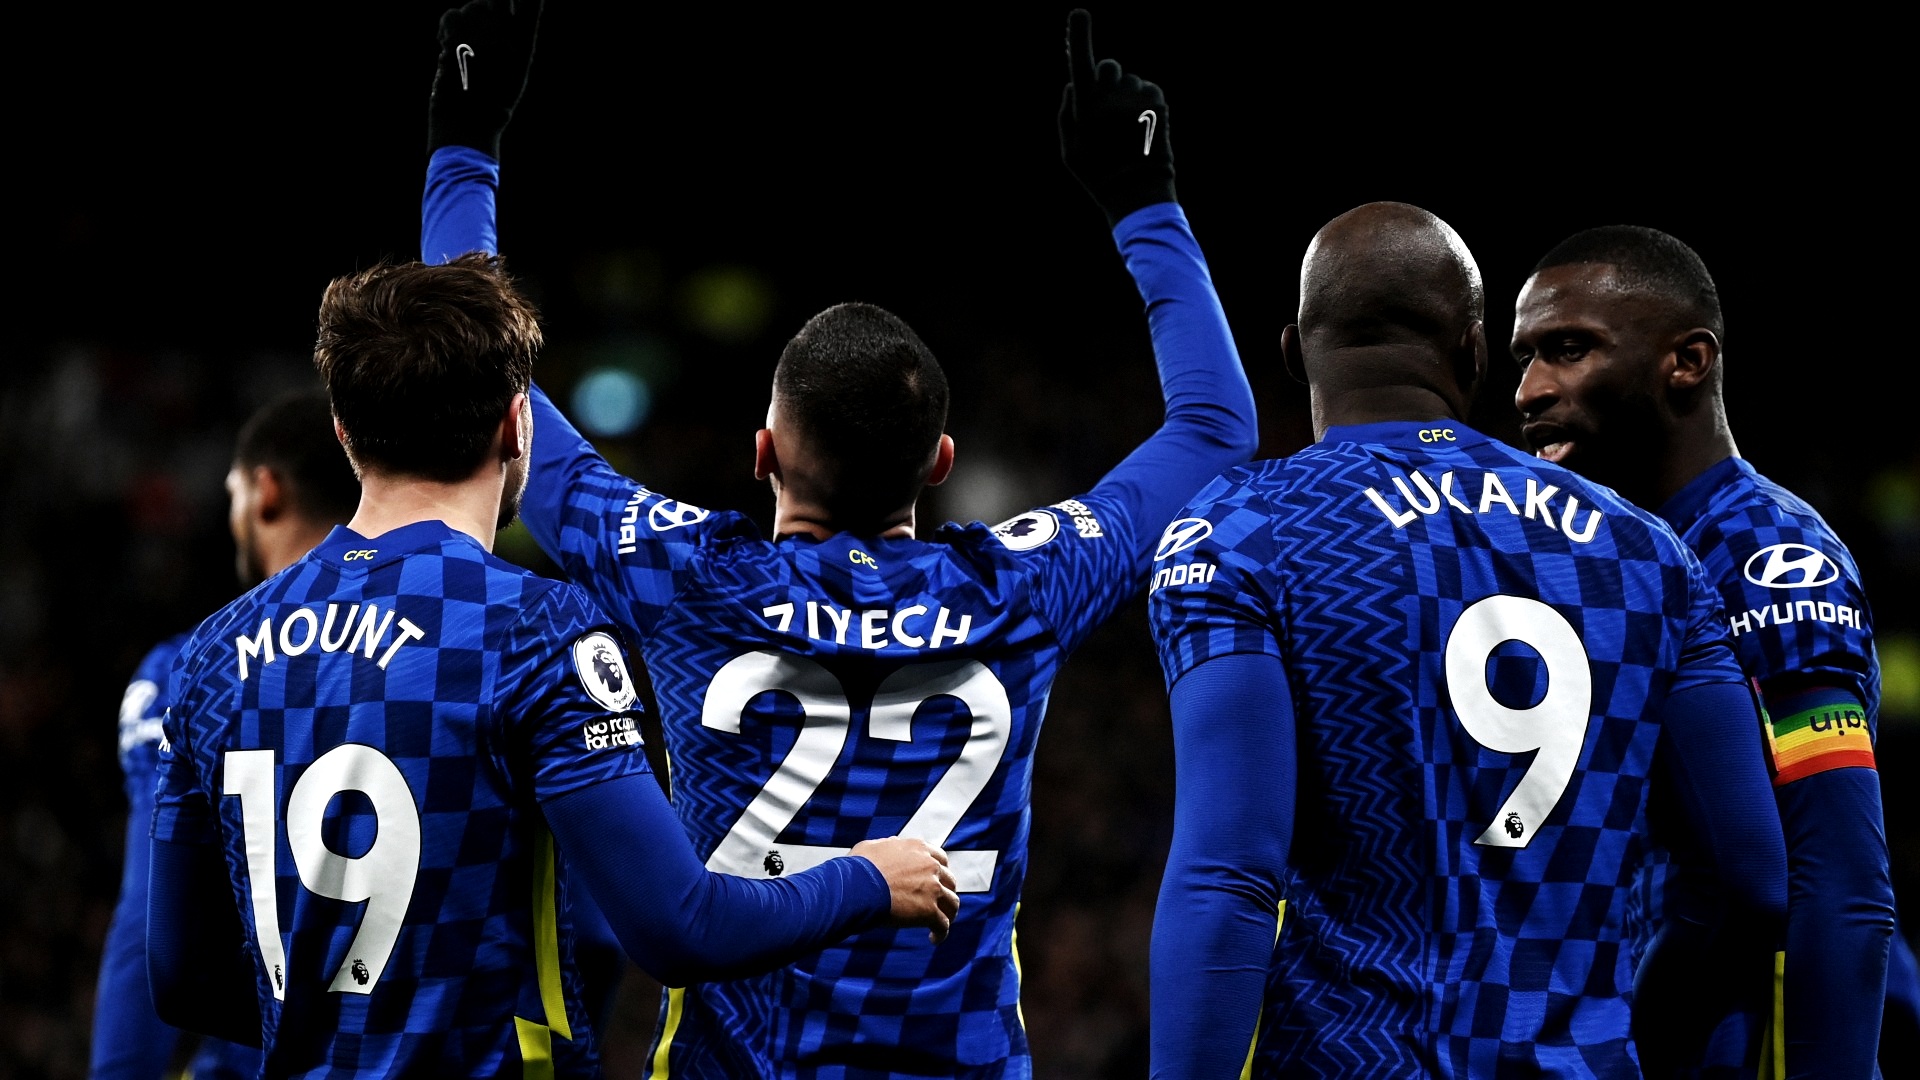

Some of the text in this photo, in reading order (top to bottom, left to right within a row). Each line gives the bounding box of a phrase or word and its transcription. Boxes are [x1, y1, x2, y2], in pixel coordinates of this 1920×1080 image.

[1418, 428, 1457, 443] CFC
[1363, 469, 1604, 543] LUKAKU
[343, 549, 378, 561] CFC
[849, 549, 878, 569] CFC
[1149, 563, 1217, 595] UNDAI
[235, 602, 425, 681] MOUNT
[763, 601, 972, 649] ZIYECH
[1730, 600, 1862, 637] HYUNDAI
[1445, 594, 1592, 848] 9
[701, 651, 1012, 892] 22
[222, 743, 422, 1001] 19
